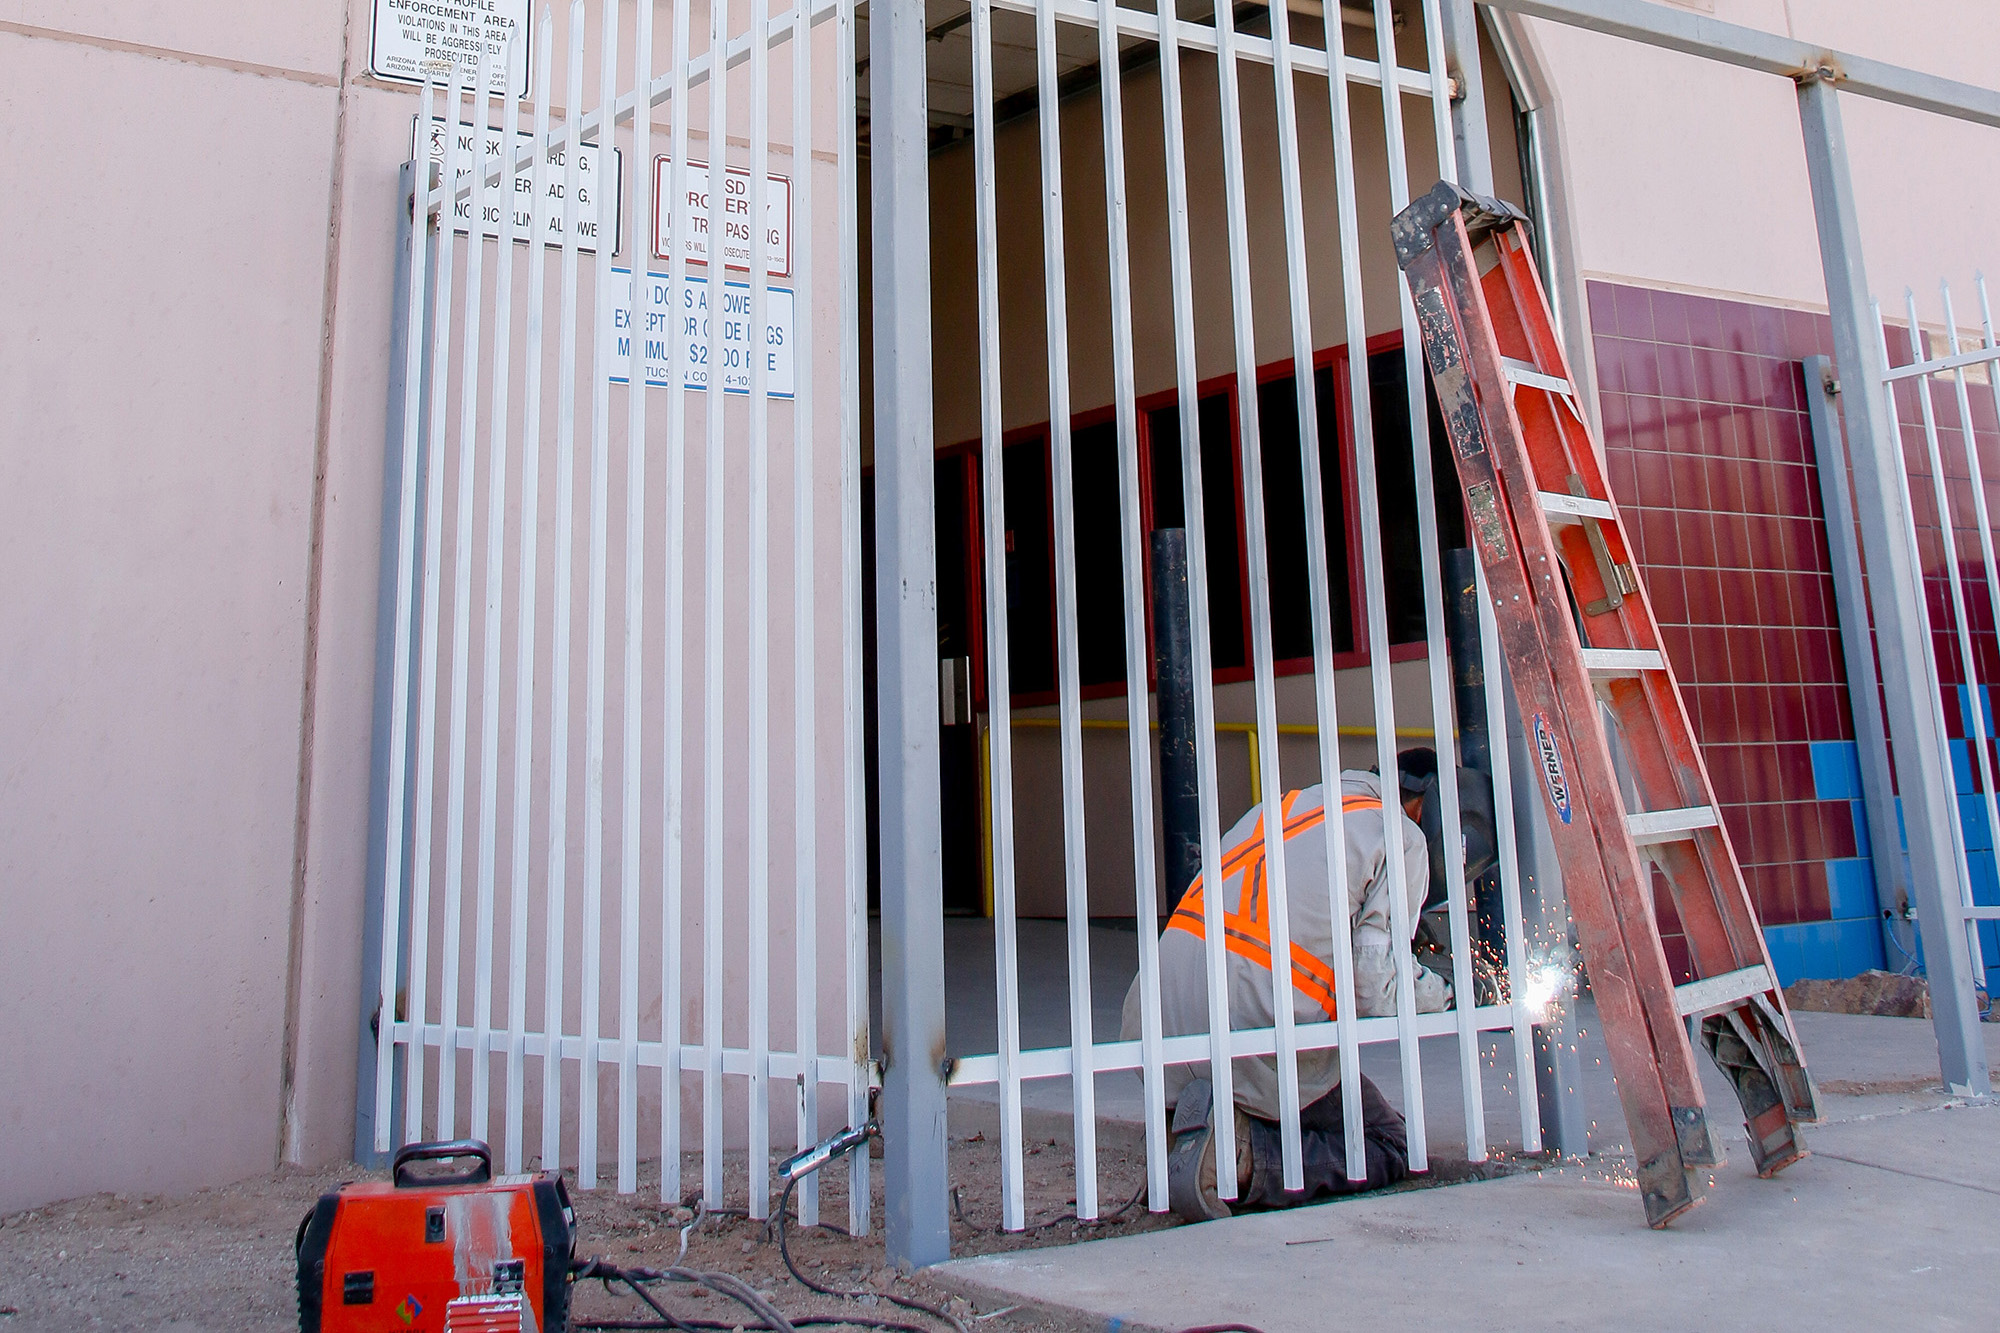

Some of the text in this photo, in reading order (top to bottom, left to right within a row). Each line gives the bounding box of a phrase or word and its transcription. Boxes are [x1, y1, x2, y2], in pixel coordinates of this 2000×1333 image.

[389, 0, 515, 28] ENFORCEMENT AREA
[398, 14, 507, 42] VIOLATIONS IN THIS AREA
[402, 29, 502, 55] WILL BE AGGRESSIELY
[386, 55, 417, 65] ARIZONA
[386, 63, 416, 72] ARIZONA
[420, 68, 451, 77] DEPARTM
[692, 216, 779, 245] TRPASG
[693, 242, 706, 253] WILL
[724, 246, 749, 260] OSECUTE
[615, 308, 666, 333] EXPT
[618, 336, 668, 361] MIMU
[689, 343, 740, 368] $200
